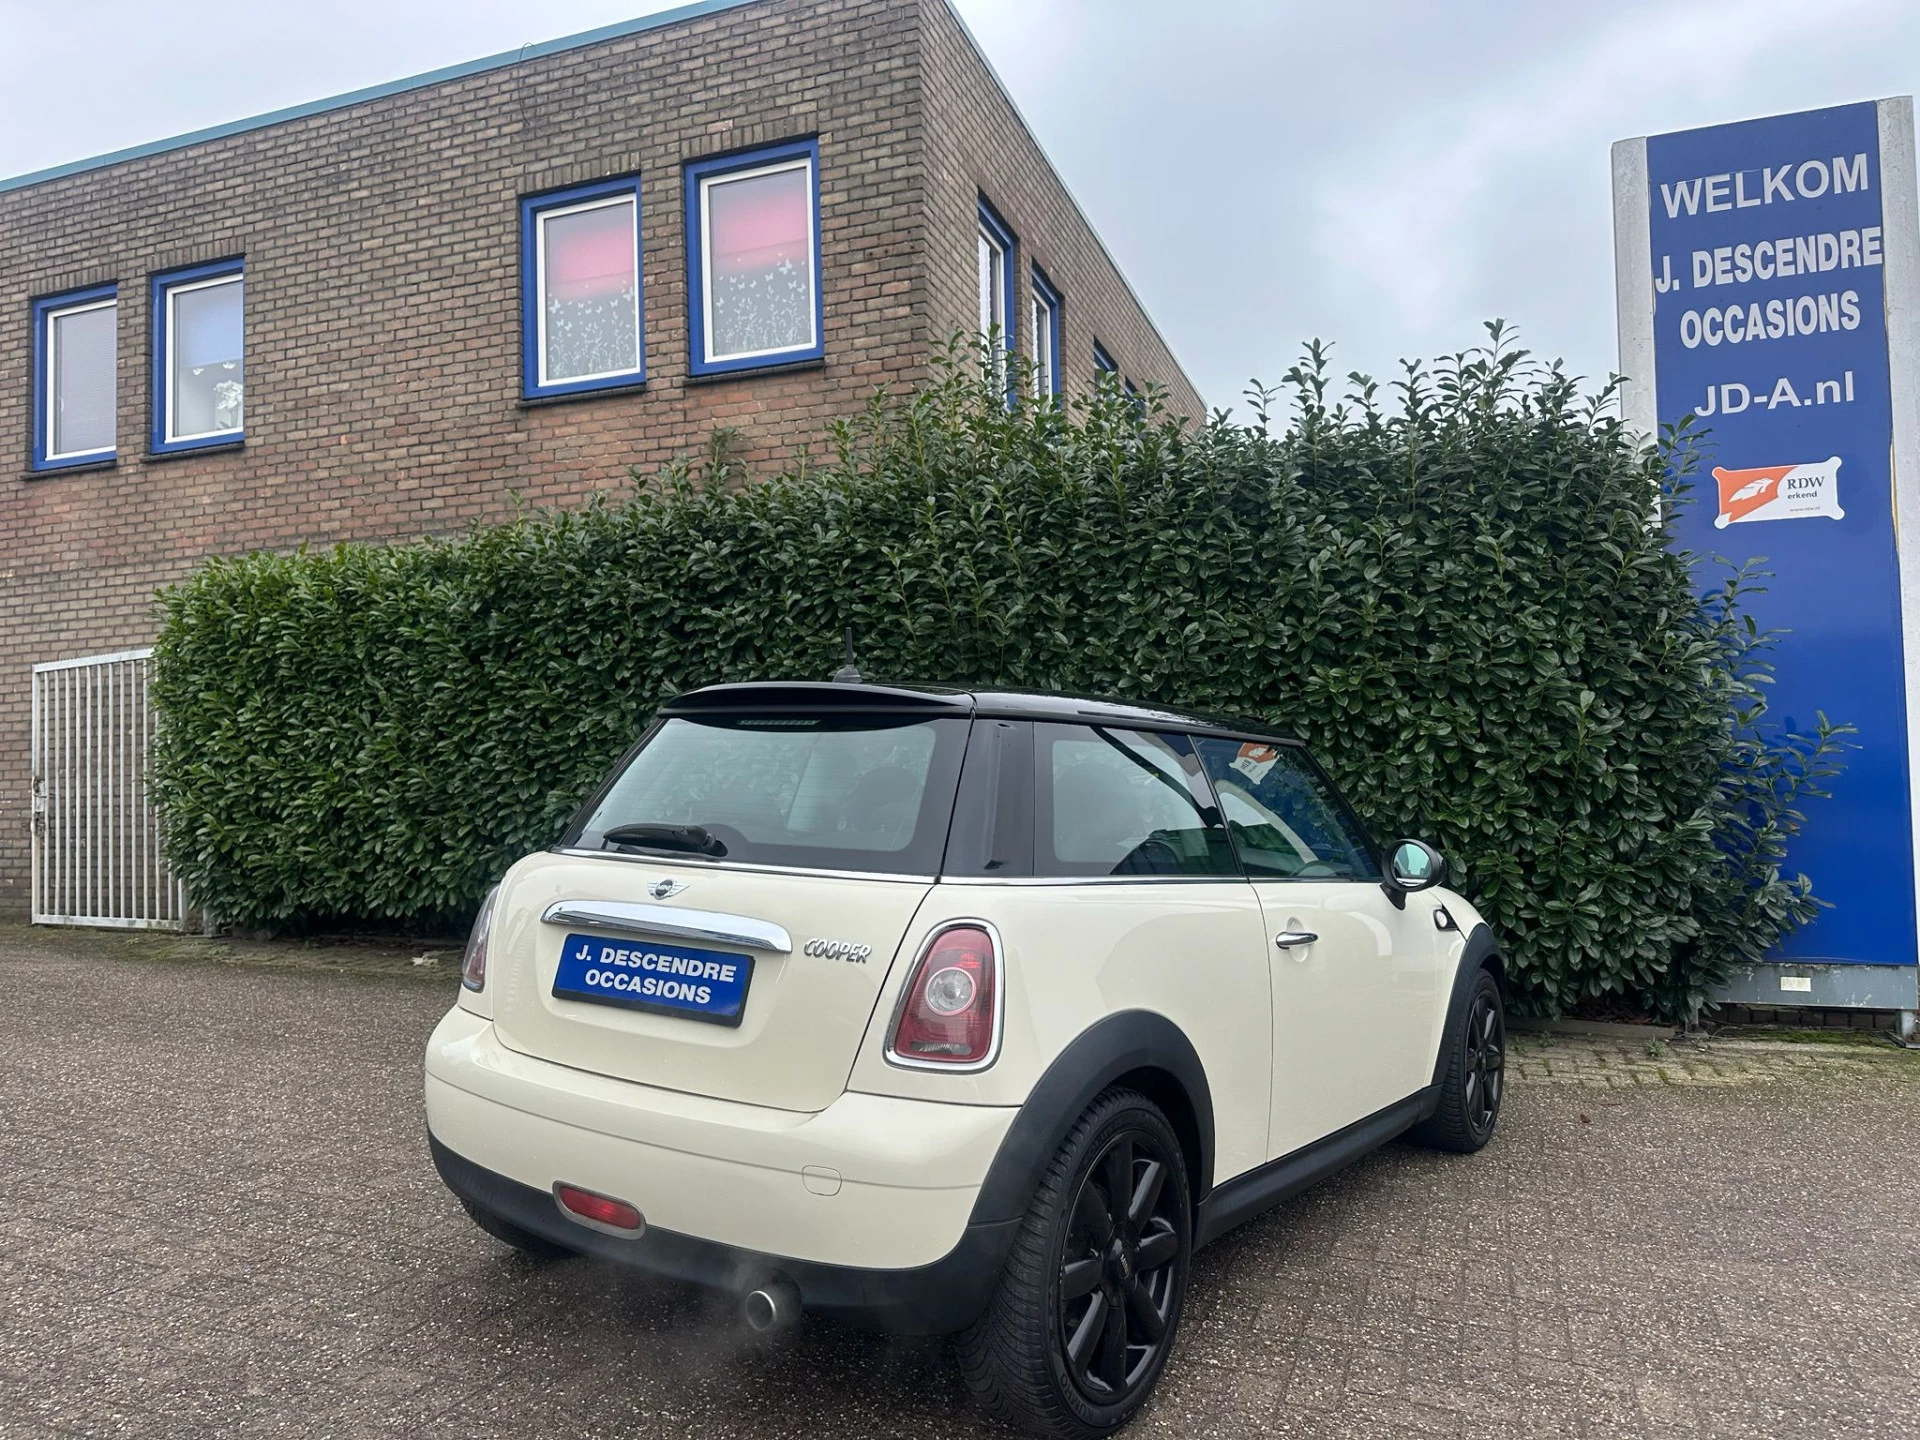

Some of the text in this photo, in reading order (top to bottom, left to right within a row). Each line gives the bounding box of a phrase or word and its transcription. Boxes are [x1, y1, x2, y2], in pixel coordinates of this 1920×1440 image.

[1660, 153, 1869, 219] WELKOM
[1654, 226, 1883, 294] J. DESCENDRE
[1680, 290, 1861, 349] OCCASIONS
[1694, 370, 1855, 417] JD-A.nl
[1787, 476, 1825, 489] RDW
[1787, 491, 1818, 500] erkend
[576, 944, 737, 983] J. DESCENDRE
[803, 937, 872, 964] COOPER
[584, 968, 711, 1005] OCCASIONS
